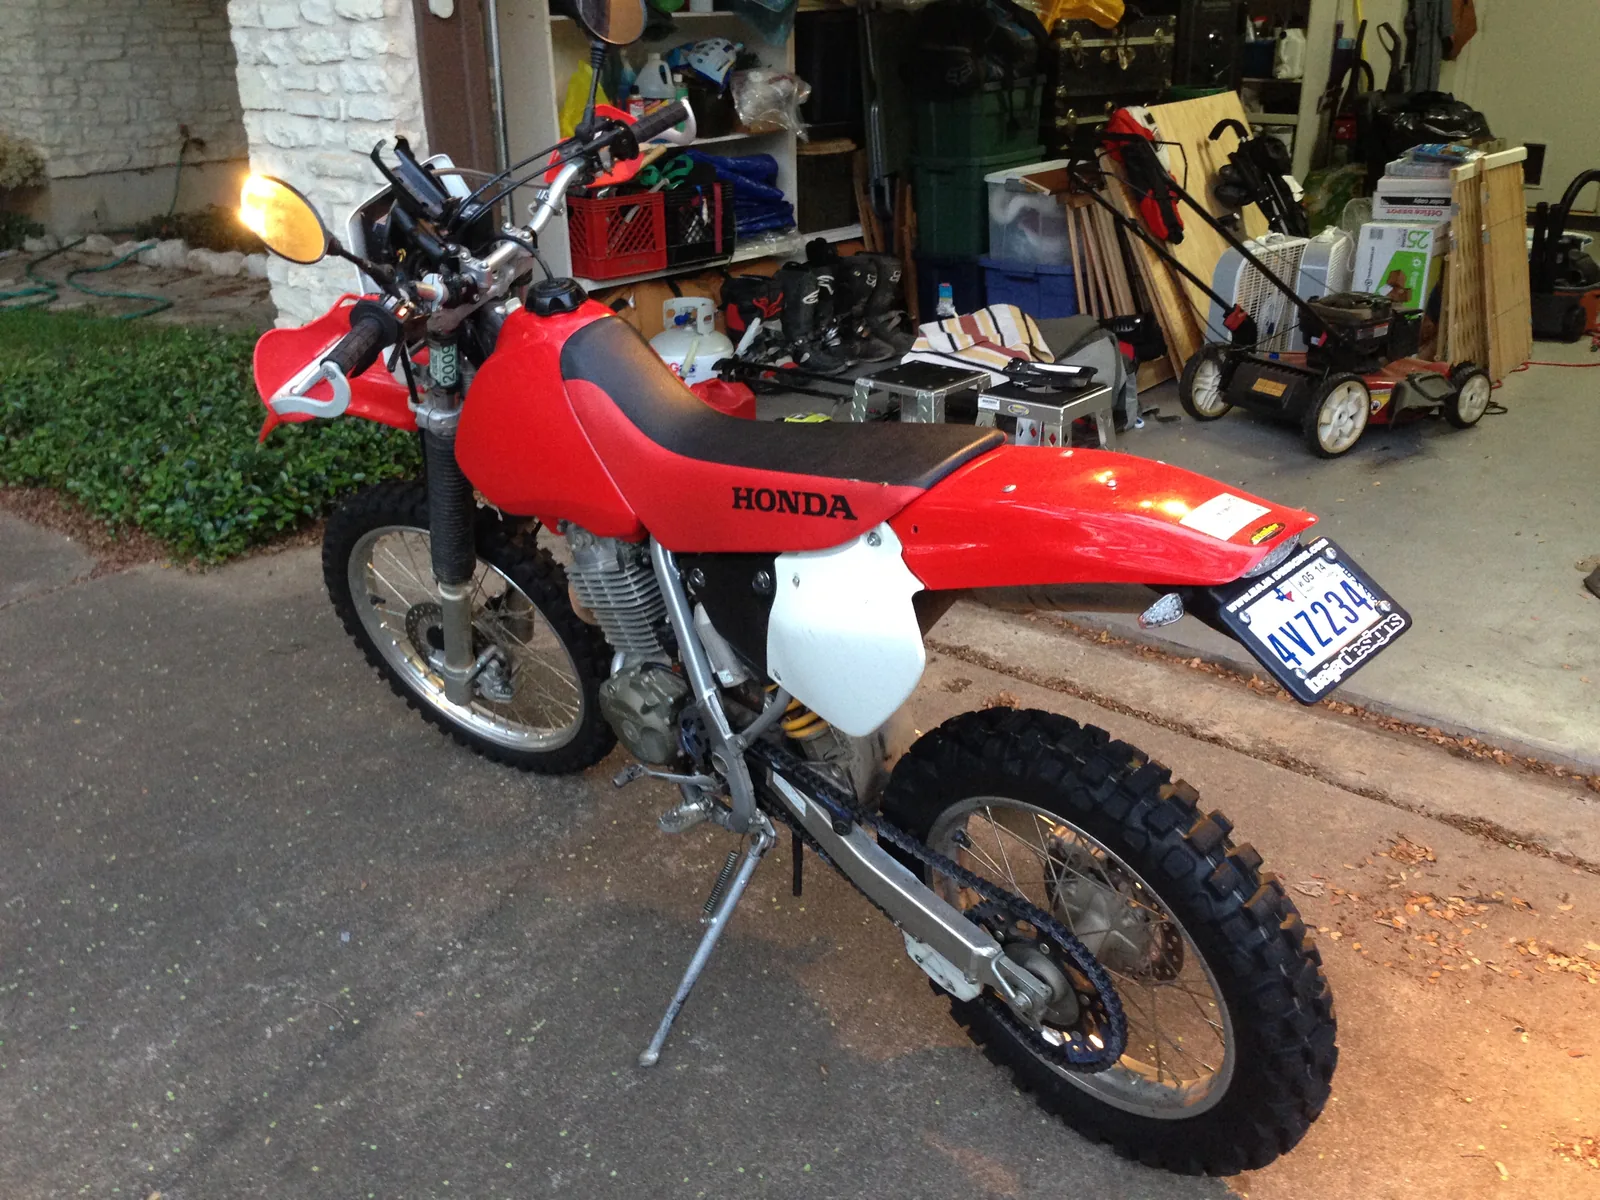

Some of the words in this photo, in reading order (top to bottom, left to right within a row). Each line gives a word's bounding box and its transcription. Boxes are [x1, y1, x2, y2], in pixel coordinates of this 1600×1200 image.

[1407, 229, 1431, 249] 25
[732, 487, 857, 520] HONDA
[1301, 569, 1315, 583] 05
[1314, 561, 1327, 574] 14
[1266, 580, 1374, 667] 4VZ234
